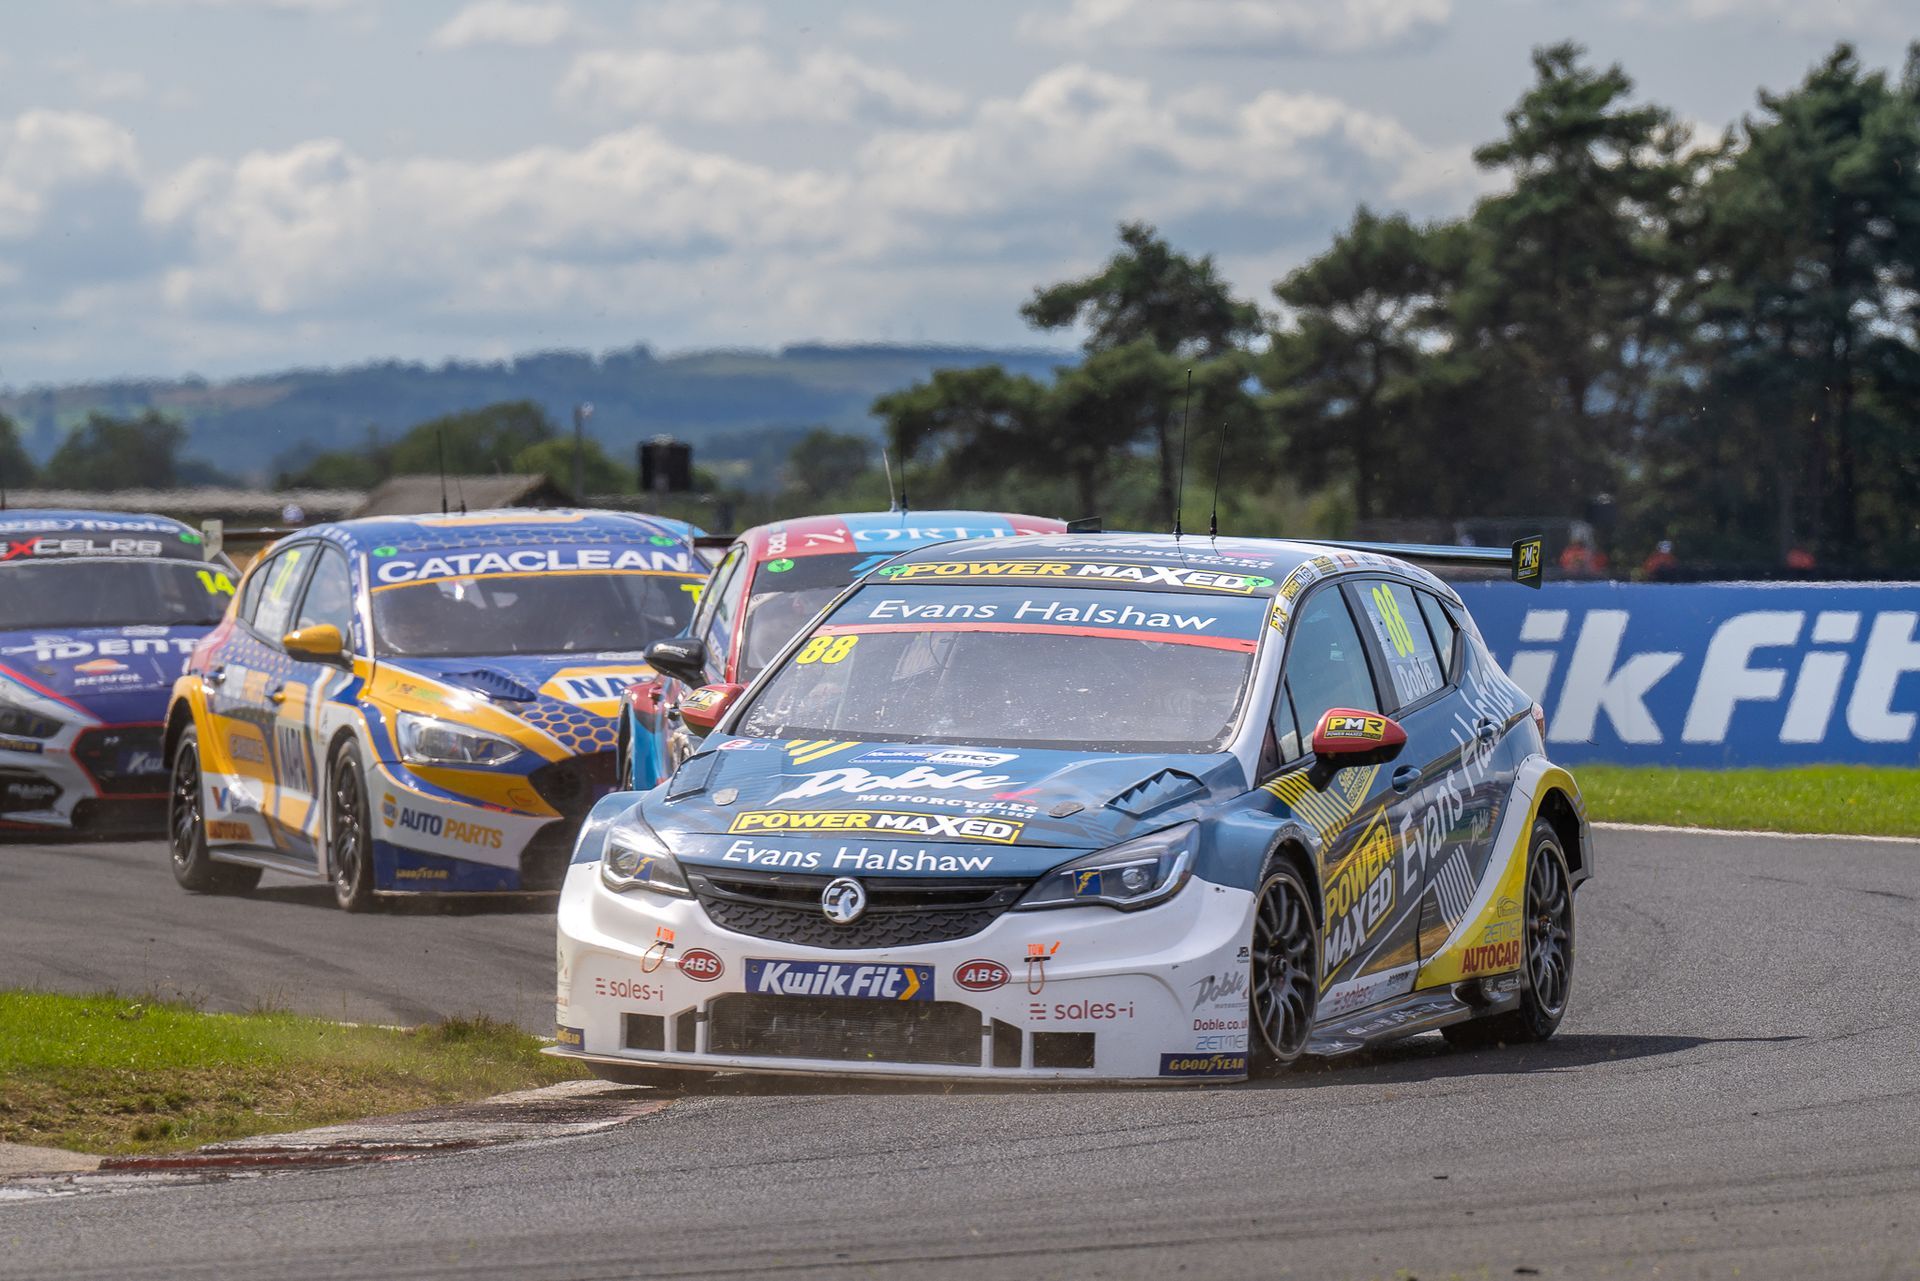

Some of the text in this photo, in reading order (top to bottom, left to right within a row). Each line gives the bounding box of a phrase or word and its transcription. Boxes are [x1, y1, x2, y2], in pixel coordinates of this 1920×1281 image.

[377, 550, 690, 583] CATACLEAN
[902, 563, 1246, 588] POWER MAXED
[197, 570, 236, 596] 14
[868, 600, 1217, 629] Evans Halshaw
[1372, 583, 1415, 658] 88
[795, 635, 859, 664] 88
[1328, 717, 1383, 732] PMR
[766, 766, 1027, 806] Doble
[855, 794, 1038, 814] MOTORCYCLES
[400, 807, 503, 849] AUTO PARTS
[737, 813, 1013, 838] POWER MAXED
[1400, 770, 1464, 896] Evans
[721, 840, 993, 872] Evans Halshaw
[1325, 825, 1391, 936] POWER
[1323, 866, 1393, 978] MAXED
[683, 957, 718, 974] ABS
[1462, 940, 1520, 974] AUTOCAR
[758, 962, 902, 998] KwikFit
[963, 967, 1003, 983] ABS
[609, 979, 664, 1001] sales-i
[1055, 1000, 1134, 1020] sales-i
[1168, 1054, 1245, 1073] GOODYEAR
